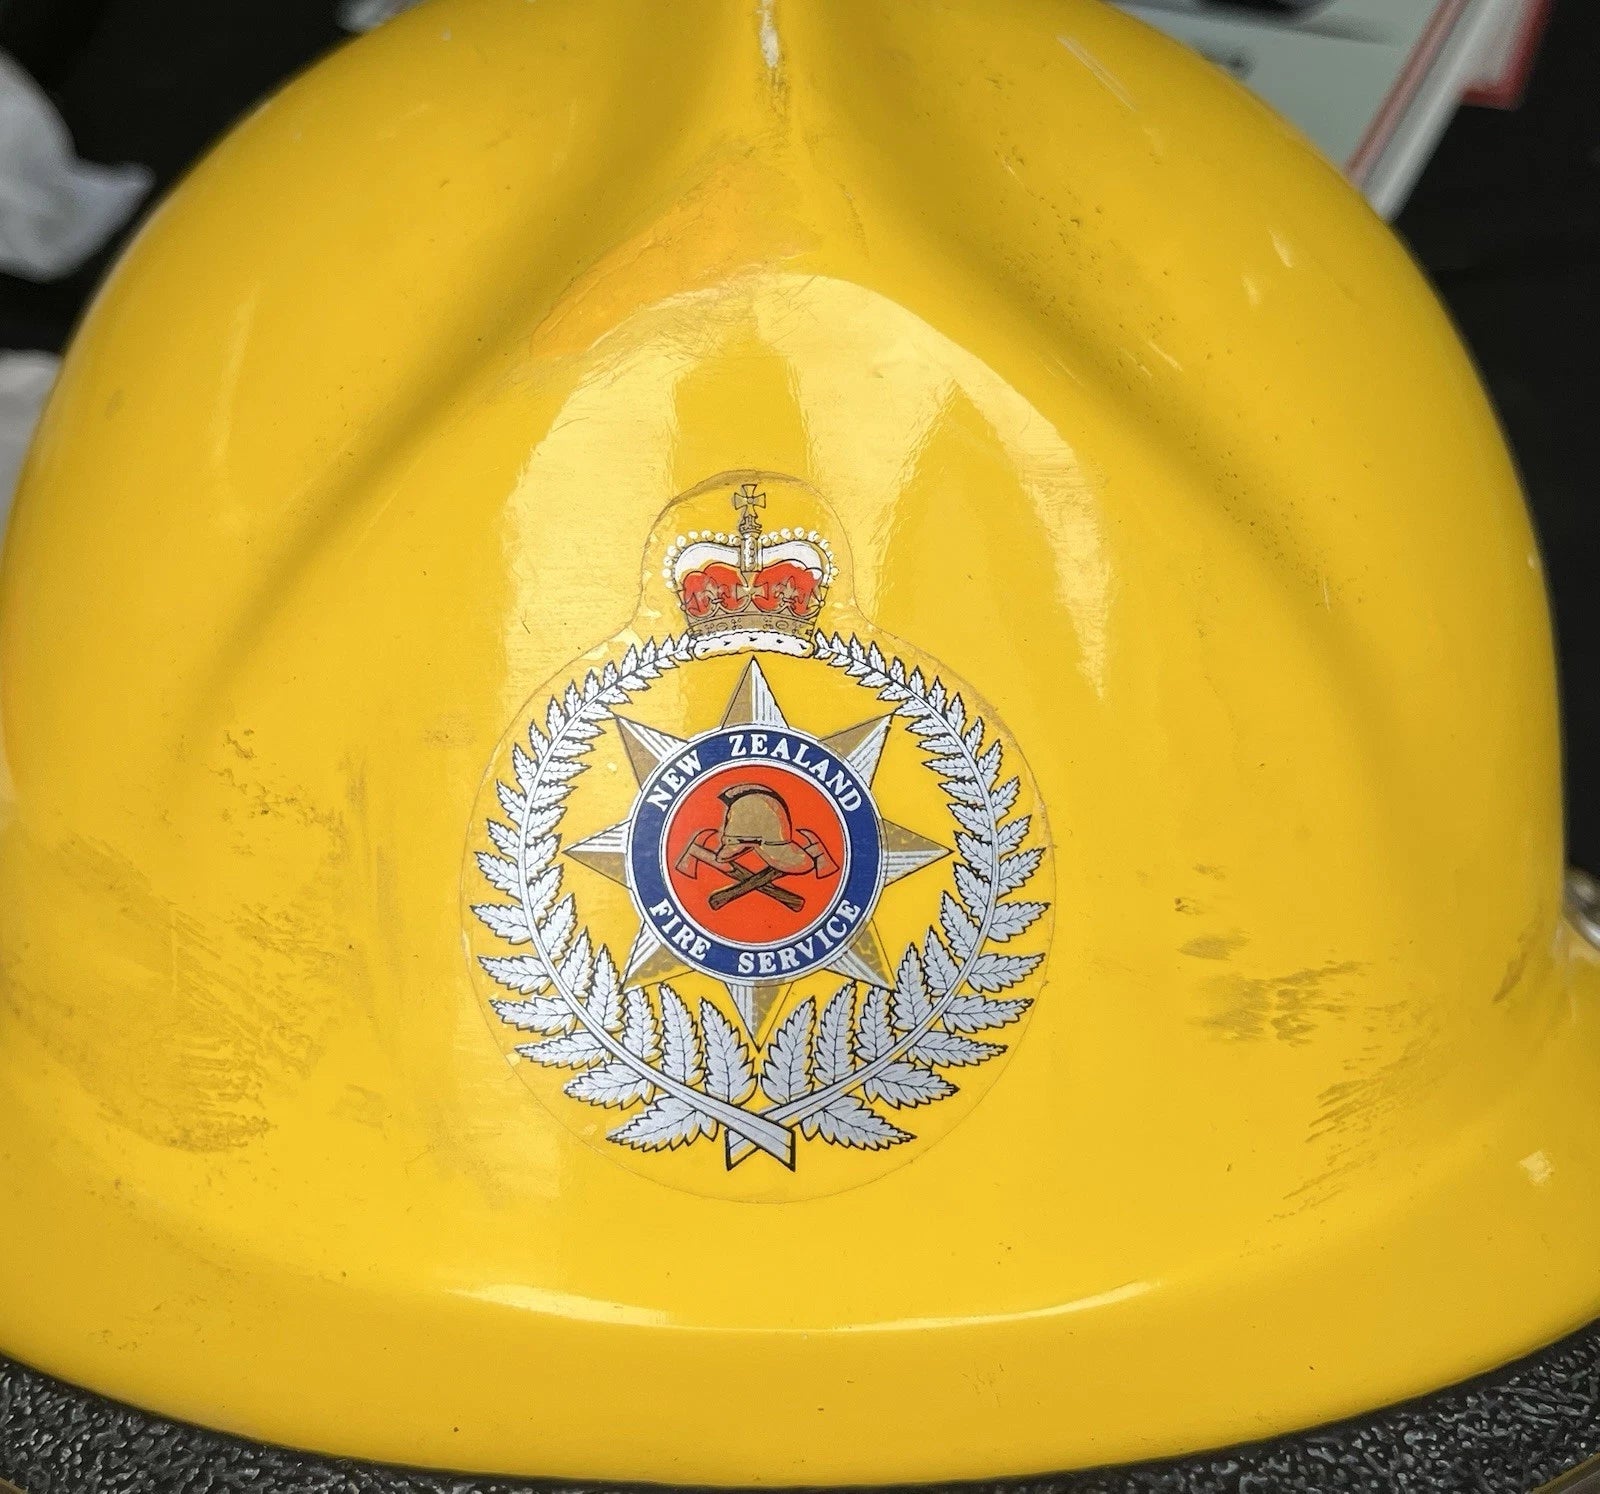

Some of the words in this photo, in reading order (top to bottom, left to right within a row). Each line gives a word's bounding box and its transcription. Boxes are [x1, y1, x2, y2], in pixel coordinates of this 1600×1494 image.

[646, 749, 703, 812] NEW
[729, 734, 862, 812] ZEALAND
[649, 898, 712, 961] FIRE
[738, 899, 862, 974] SERVICE
